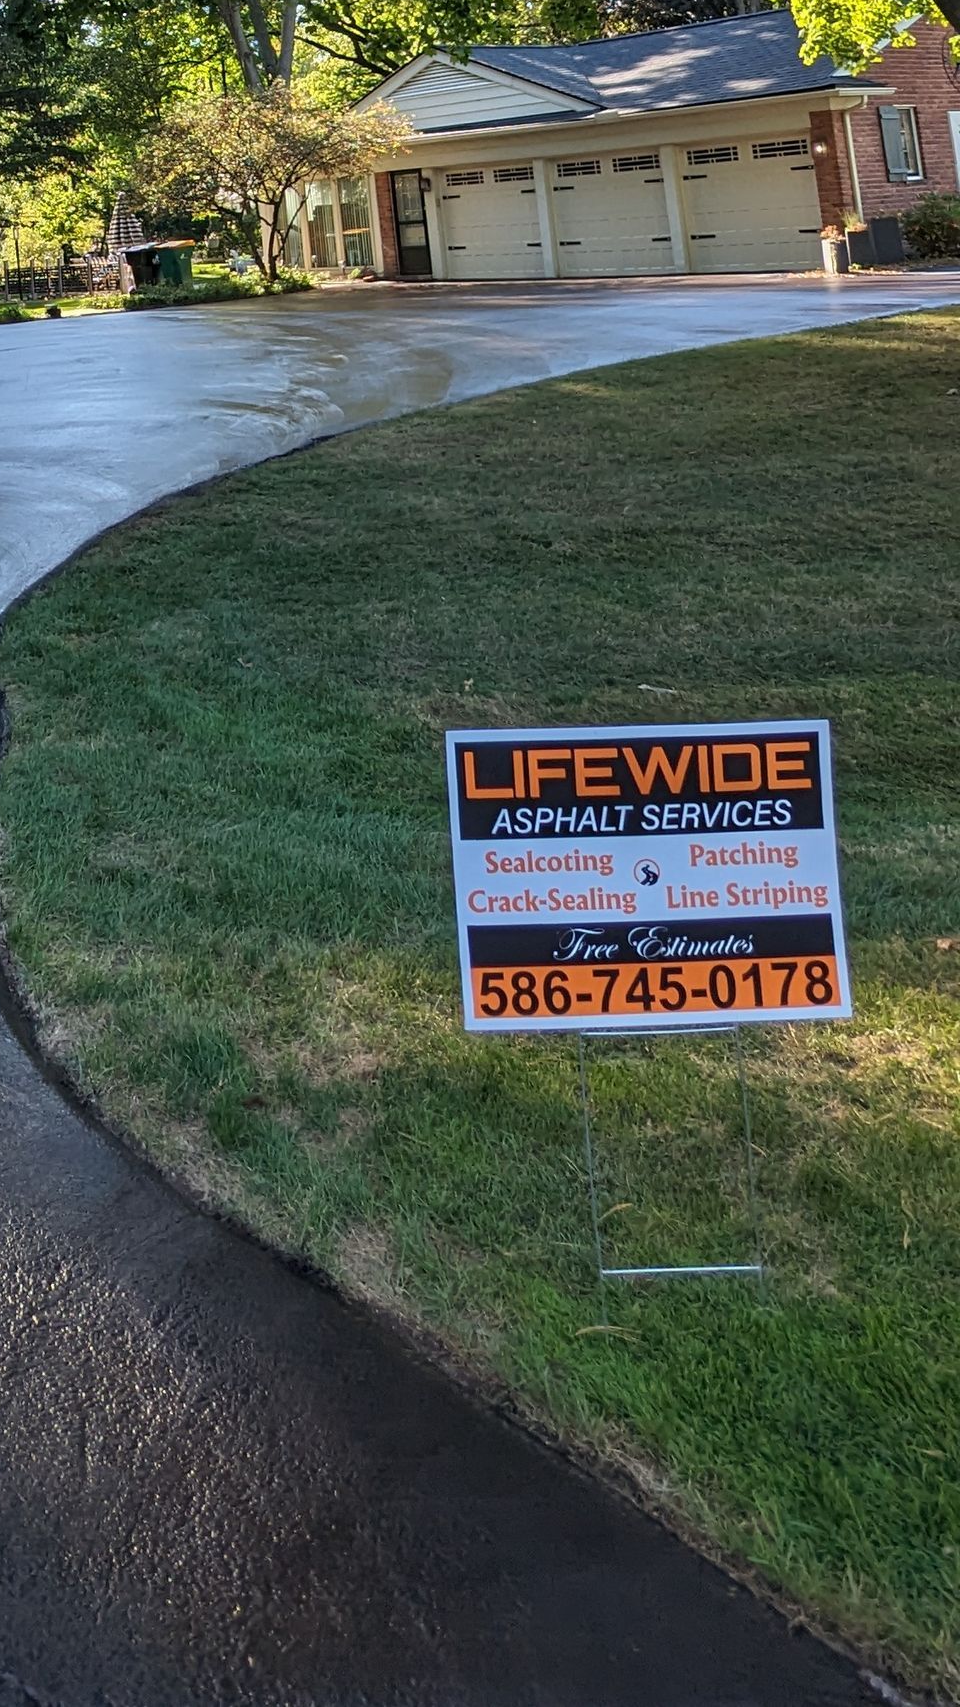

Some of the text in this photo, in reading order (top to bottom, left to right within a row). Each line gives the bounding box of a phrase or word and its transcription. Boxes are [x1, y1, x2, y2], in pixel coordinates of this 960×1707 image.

[463, 741, 812, 799] LIFEWIDE
[491, 800, 792, 834] ASPHALT SERVICES
[485, 849, 614, 875] Sealcoting
[688, 842, 798, 867] Patching
[468, 888, 637, 914] Crack-Sealing
[667, 881, 828, 909] Line Striping
[553, 926, 754, 961] Free Estimates
[480, 960, 833, 1017] 586-745-0178
